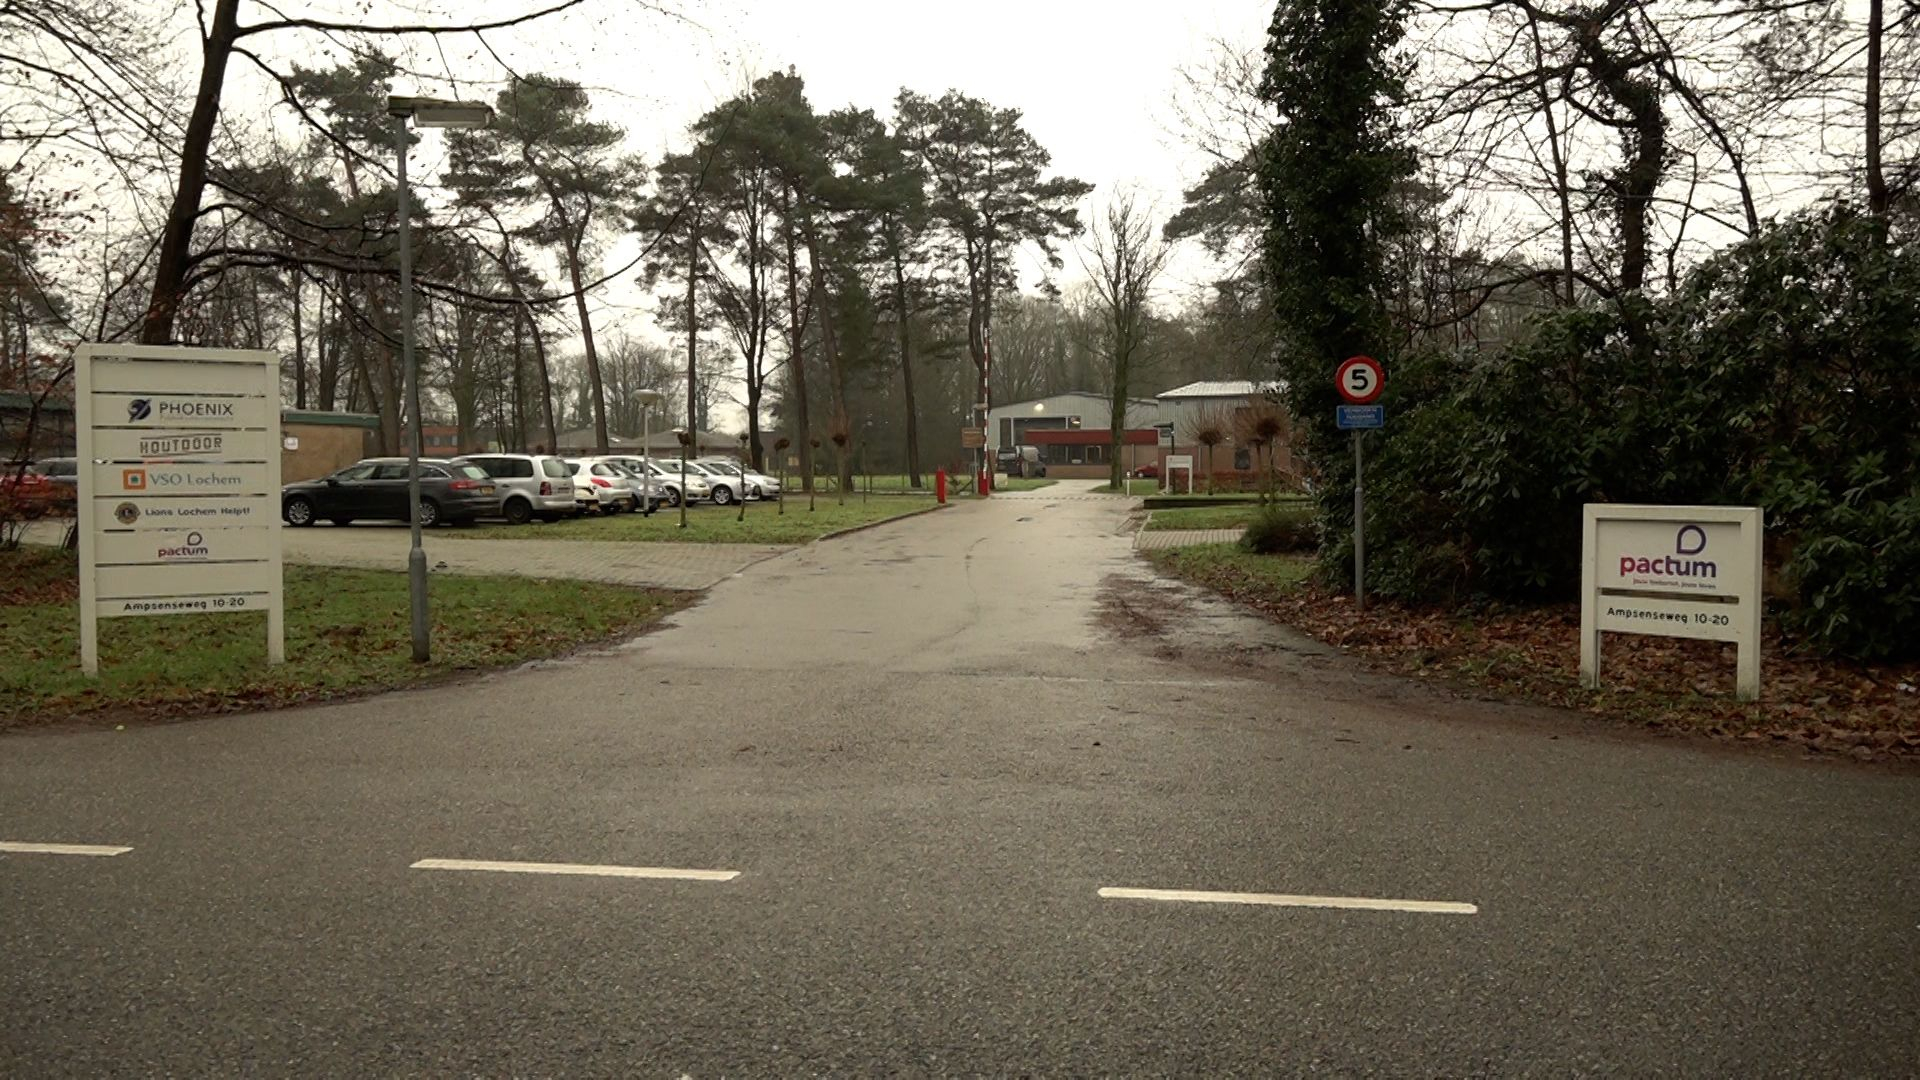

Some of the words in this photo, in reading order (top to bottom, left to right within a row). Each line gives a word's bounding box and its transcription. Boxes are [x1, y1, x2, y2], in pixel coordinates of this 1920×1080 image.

[1351, 369, 1368, 390] 5
[159, 403, 233, 416] PHOENIX
[140, 437, 222, 454] HOUTDOOR
[150, 473, 182, 485] VSO
[187, 472, 241, 485] Lochem
[178, 507, 217, 516] Lochem
[158, 546, 208, 558] pactum
[1620, 555, 1717, 578] pactum
[124, 600, 207, 612] Ampsenseweg
[212, 597, 245, 608] 10-20
[1607, 607, 1688, 624] Ampsenseweg
[1694, 613, 1729, 626] 10-20
